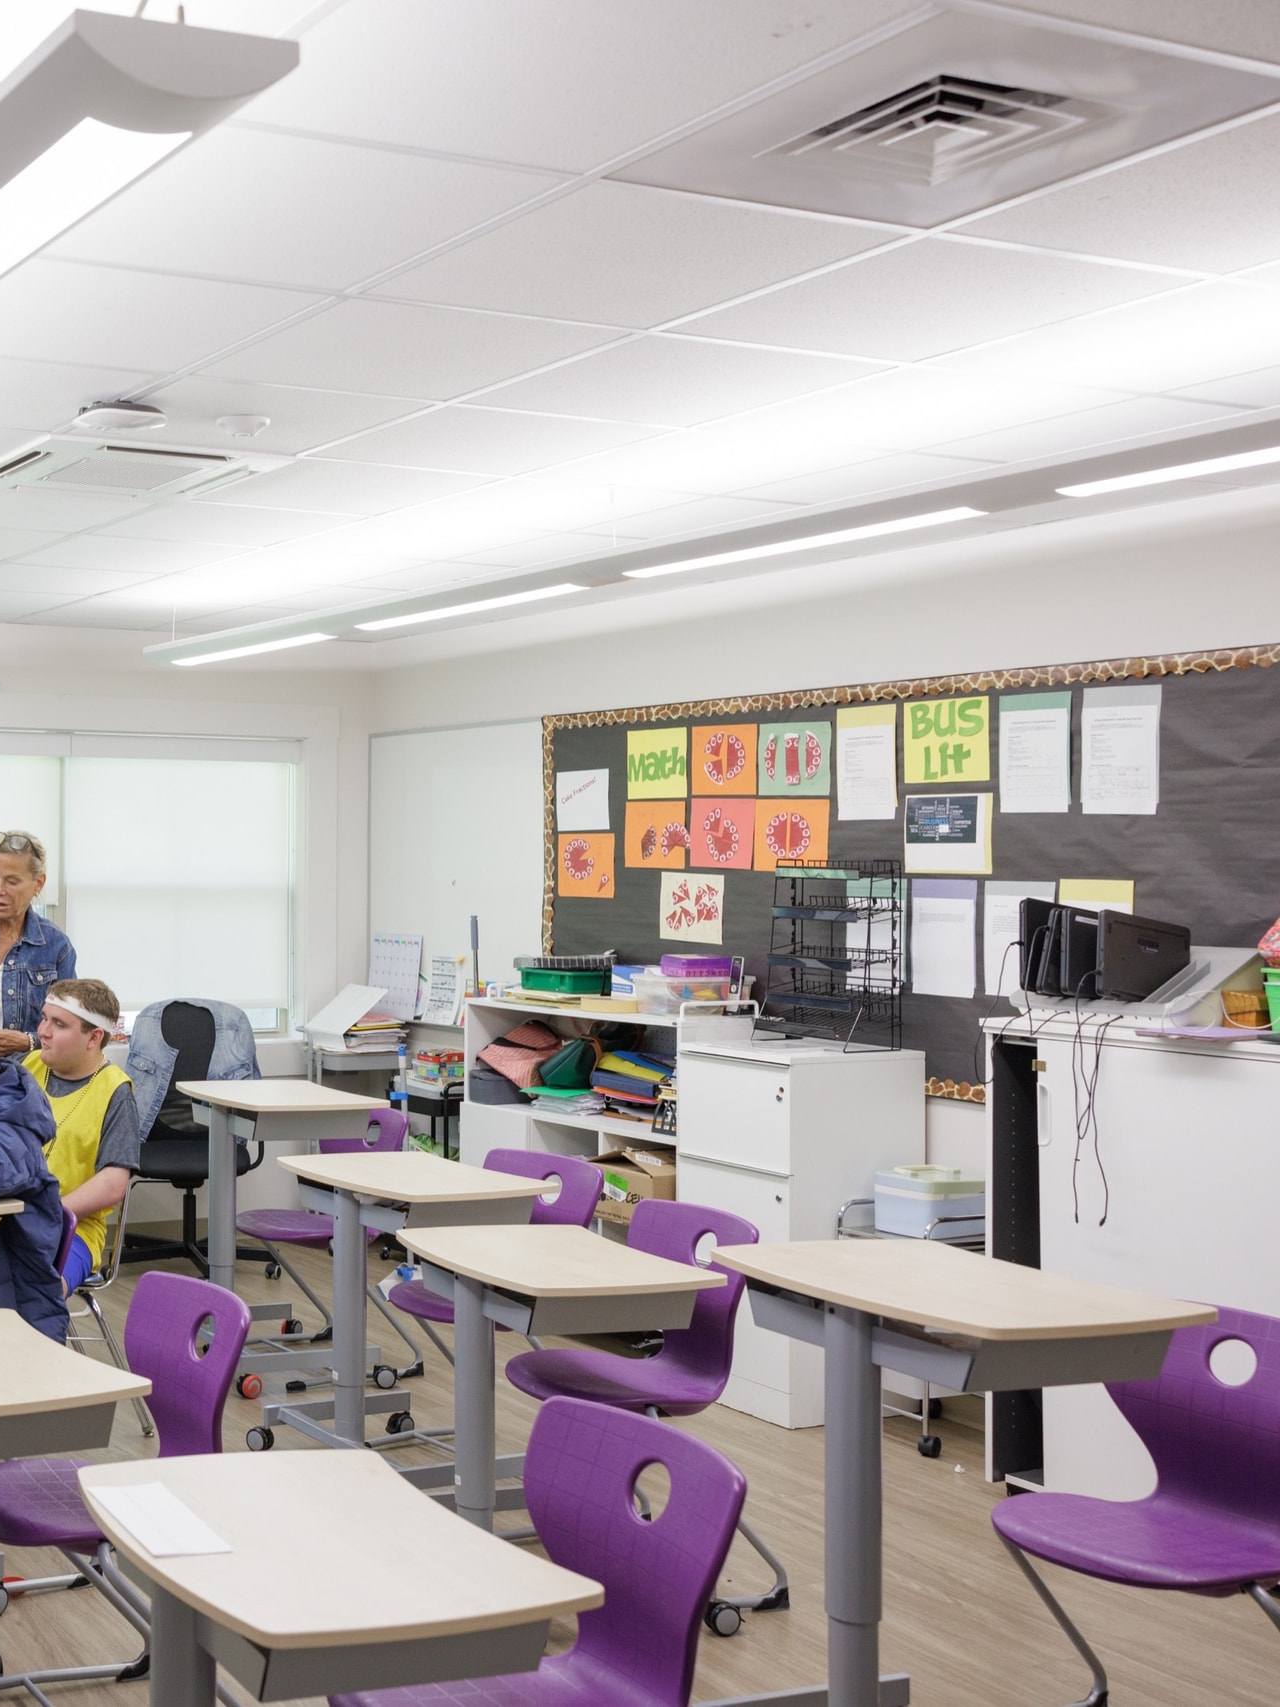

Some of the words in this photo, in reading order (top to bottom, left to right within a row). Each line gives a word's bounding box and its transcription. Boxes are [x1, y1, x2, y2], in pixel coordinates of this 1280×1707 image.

[910, 699, 984, 740] BUS
[628, 746, 685, 783] Math
[923, 741, 971, 780] Lit
[561, 792, 573, 805] Cake
[572, 776, 598, 797] Fractions!
